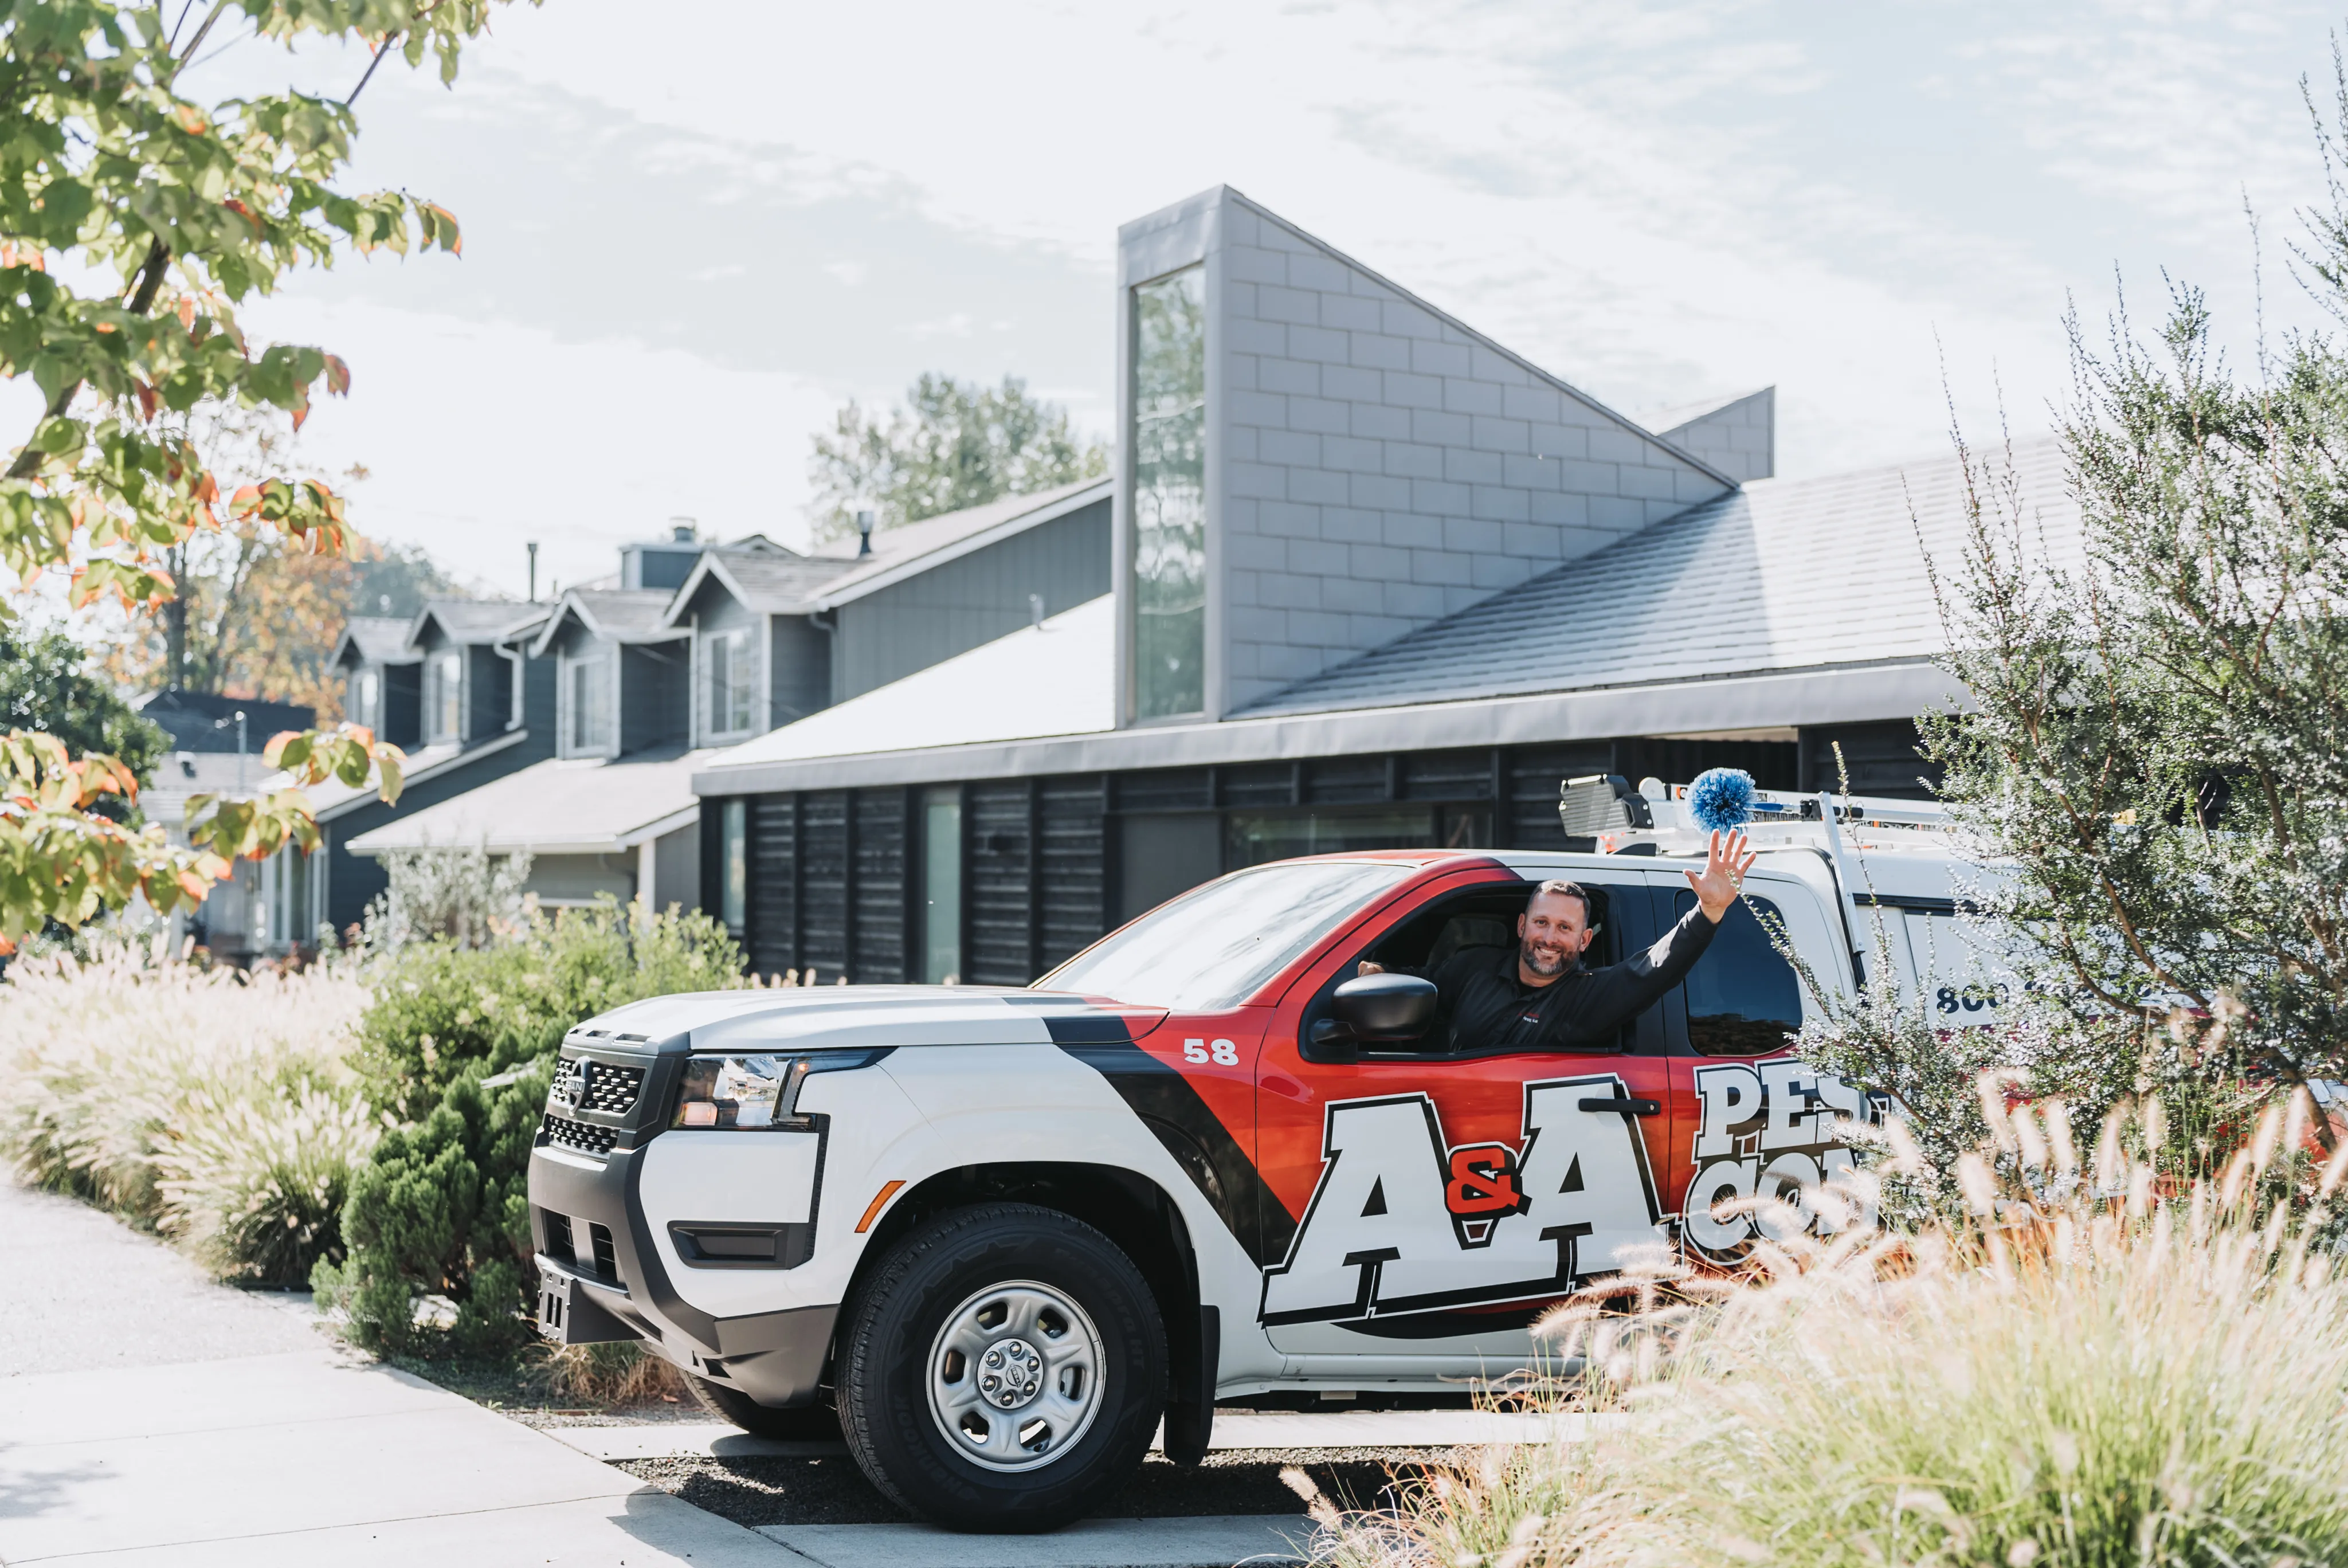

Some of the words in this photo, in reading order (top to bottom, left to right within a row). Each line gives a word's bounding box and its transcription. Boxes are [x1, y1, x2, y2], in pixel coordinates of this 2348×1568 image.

[1937, 983, 2009, 1014] 800
[1183, 1038, 1239, 1066] 58
[1692, 1058, 1891, 1163] PES
[1261, 1073, 1682, 1330] A&A
